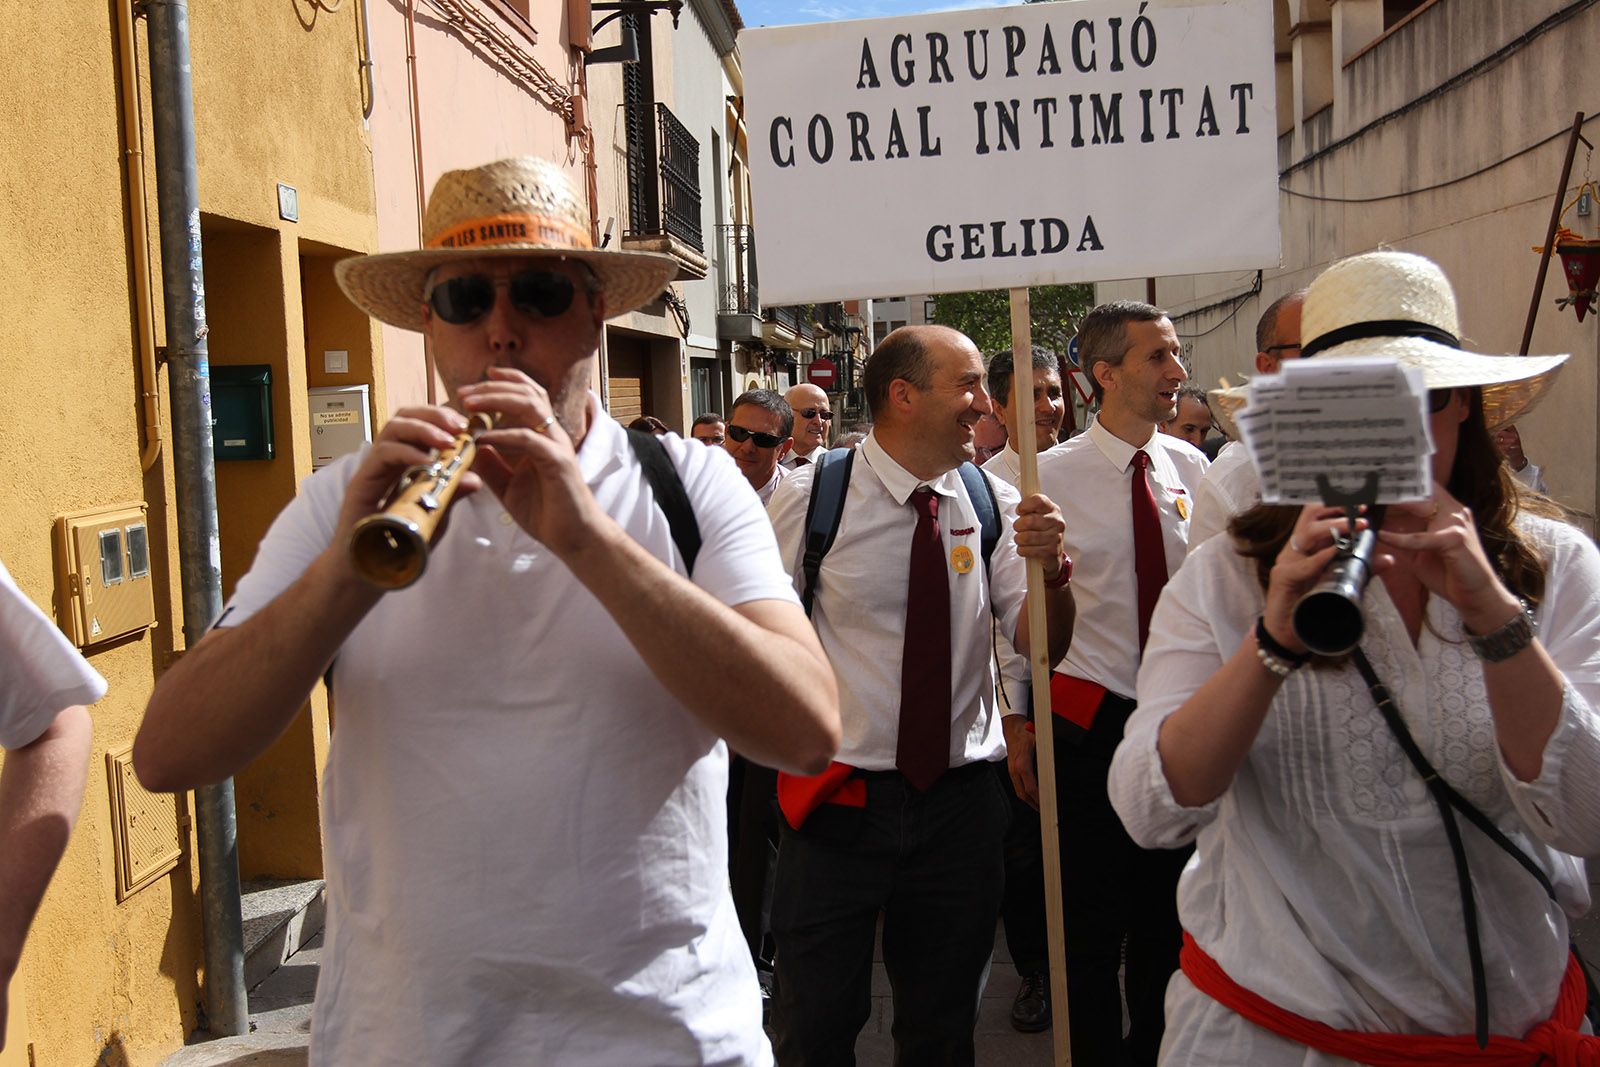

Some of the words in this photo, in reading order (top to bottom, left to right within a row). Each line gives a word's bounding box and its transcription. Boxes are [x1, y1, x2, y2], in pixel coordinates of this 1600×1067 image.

[856, 2, 1157, 89] AGRUPACIÓ
[769, 105, 942, 168] CORAL
[973, 83, 1254, 155] INTIMITAT
[458, 229, 476, 246] LES
[480, 223, 527, 240] SANTES
[925, 214, 1104, 262] GELIDA
